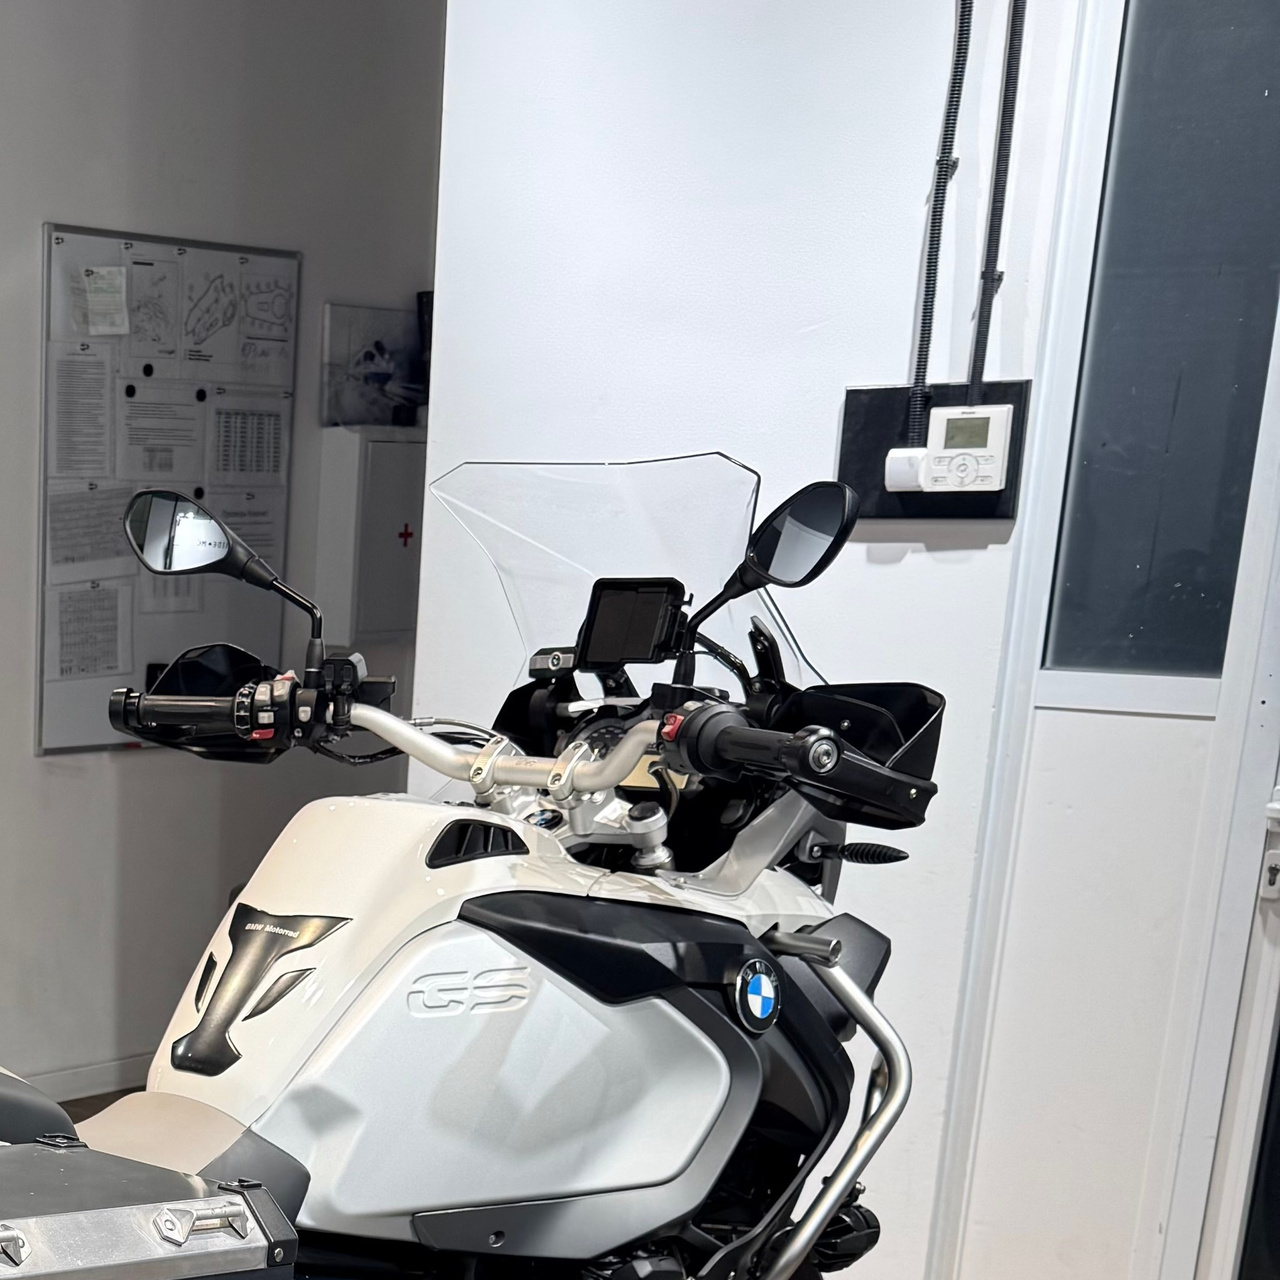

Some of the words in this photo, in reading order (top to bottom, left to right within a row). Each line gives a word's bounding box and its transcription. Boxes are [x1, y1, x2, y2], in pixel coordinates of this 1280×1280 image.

[245, 923, 264, 931] BMW
[265, 924, 300, 938] Motorrad
[742, 961, 779, 988] BMW
[406, 966, 531, 1018] GS
